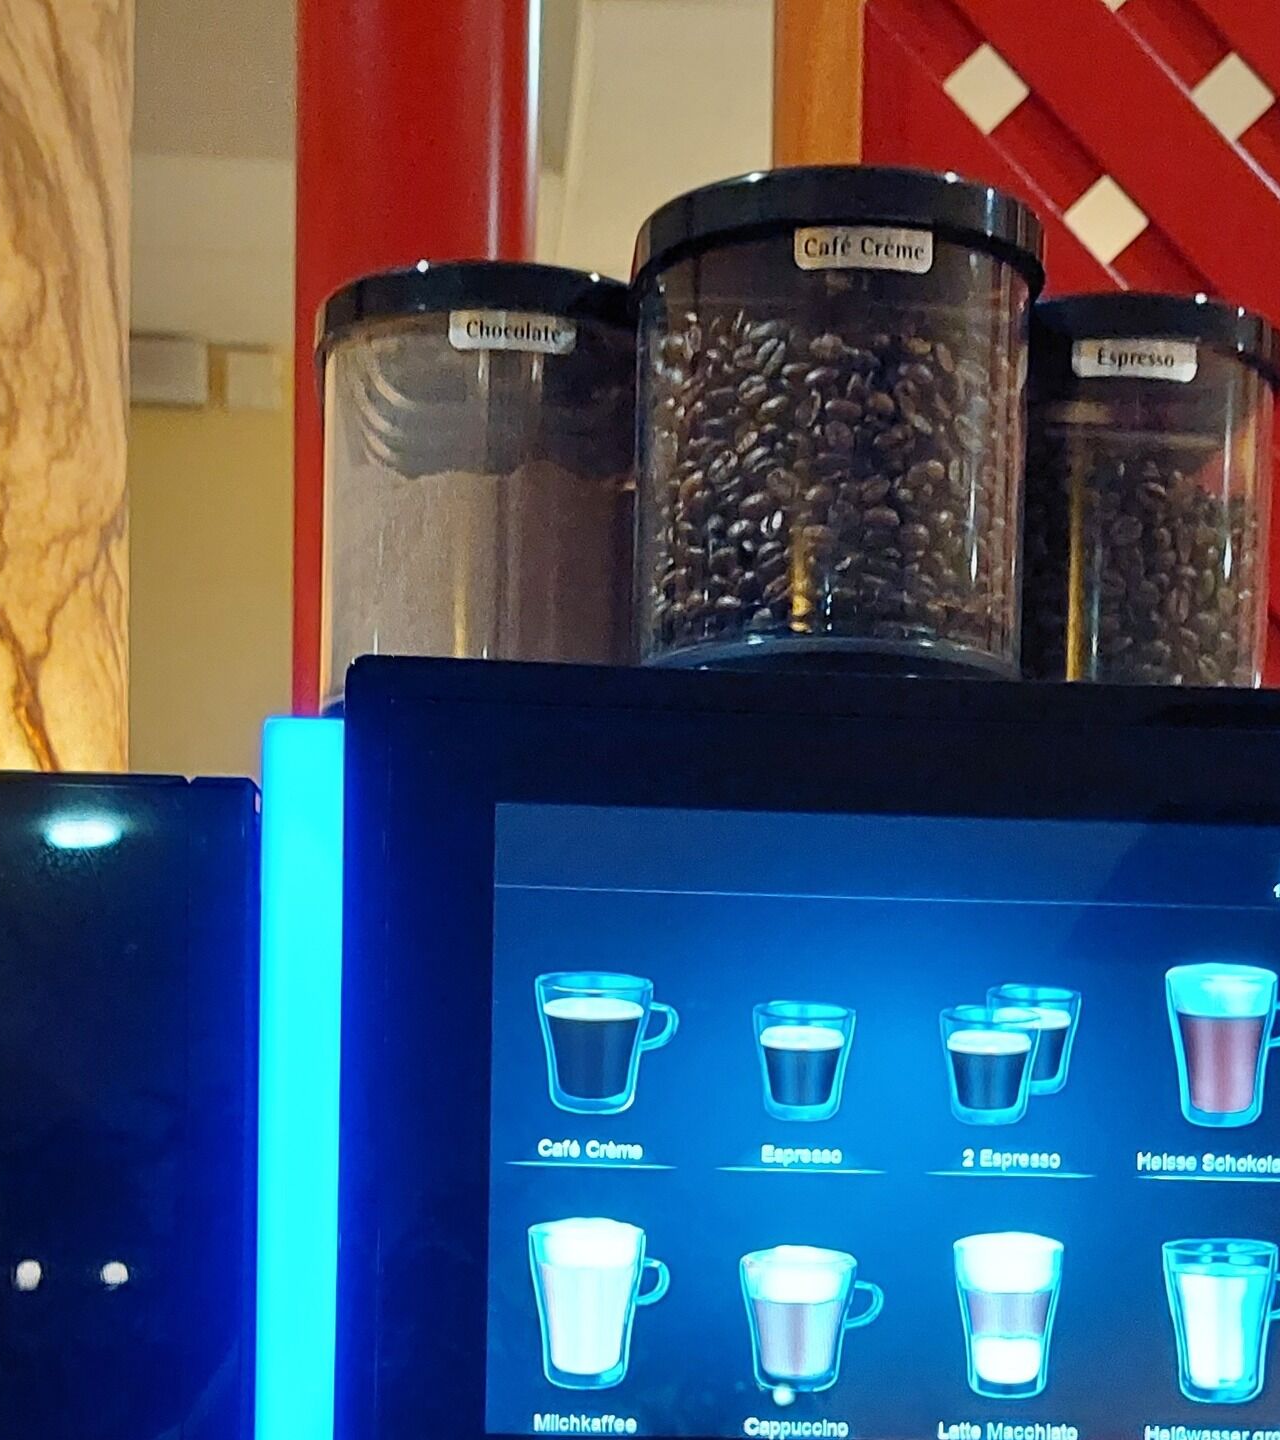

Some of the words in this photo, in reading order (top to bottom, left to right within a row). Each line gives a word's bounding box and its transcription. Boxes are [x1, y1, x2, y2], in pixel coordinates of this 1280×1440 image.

[803, 235, 851, 260] Café
[860, 236, 925, 261] Crème
[466, 320, 564, 344] Chocolate
[1097, 347, 1175, 372] Espresso
[537, 1138, 581, 1159] Café
[585, 1138, 644, 1161] Crème
[760, 1144, 843, 1167] Espresso
[961, 1148, 975, 1169] 2
[979, 1148, 1062, 1172] Espresso
[1136, 1151, 1197, 1172] Heisse
[533, 1412, 638, 1434] Milchkaffee
[743, 1416, 850, 1440] Cappuccino
[937, 1421, 982, 1440] Latte
